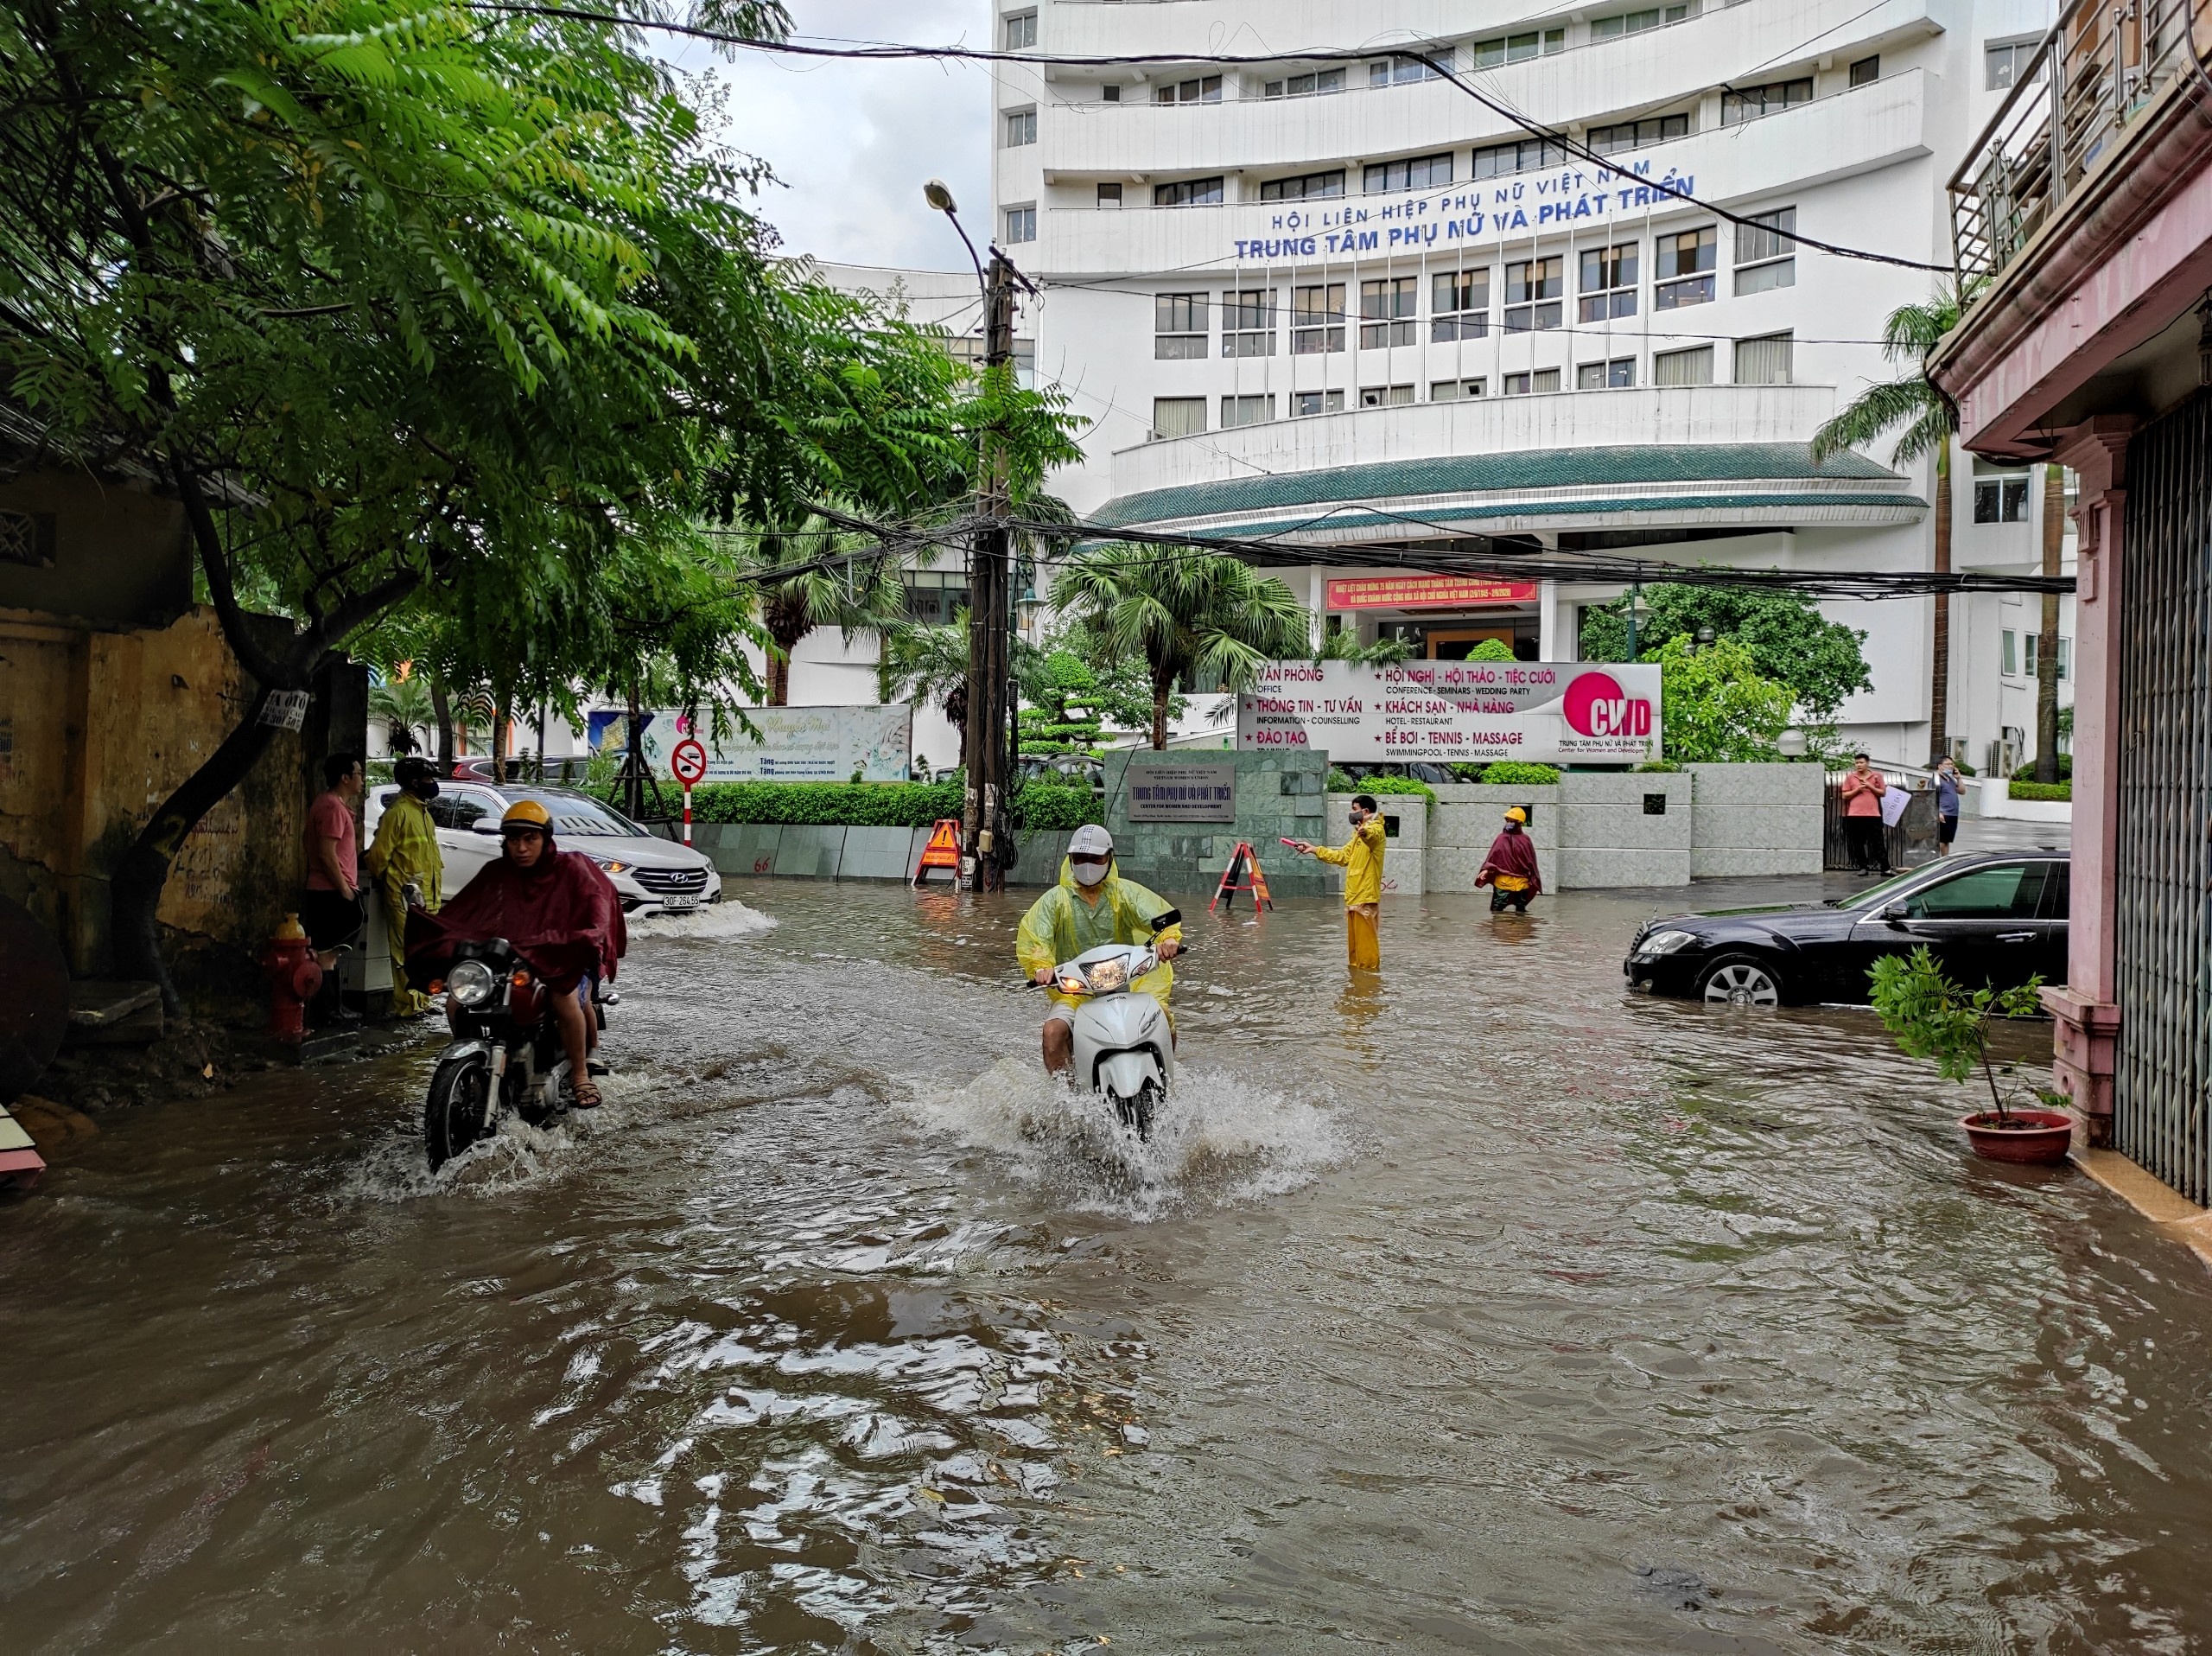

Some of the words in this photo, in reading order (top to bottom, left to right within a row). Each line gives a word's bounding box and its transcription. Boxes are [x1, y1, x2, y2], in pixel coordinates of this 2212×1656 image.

[1273, 211, 1309, 232] HỘI
[1324, 207, 1368, 226] LIÊN
[1382, 200, 1427, 220] HIỆP
[1442, 193, 1480, 212] PHỤ
[1496, 182, 1524, 203] NỮ
[1536, 173, 1583, 194] VIỆT
[1598, 160, 1650, 184] NAM
[1234, 237, 1315, 258] TRUNG
[1325, 229, 1378, 252] TÂM
[1389, 223, 1438, 247] PHỤ
[1448, 212, 1484, 239] NỮ
[1494, 205, 1529, 231] VÀ
[1539, 193, 1608, 224] PHÁT
[1618, 168, 1694, 209] TRIỂN
[1257, 666, 1281, 681] VĂN
[1284, 666, 1324, 681] PHÒNG
[1386, 667, 1404, 685] HỘI
[1408, 668, 1434, 685] NGHỊ
[1445, 667, 1464, 685] HỘI
[1466, 666, 1495, 683] THẢO
[1505, 668, 1526, 686] TIỆC
[1529, 668, 1555, 684] CƯỚI
[1386, 686, 1433, 695] CONFERENCE
[1257, 697, 1295, 713] THÔNG
[1298, 700, 1313, 712] TIN
[1325, 699, 1336, 712] TƯ
[1339, 695, 1362, 713] VẤN
[1386, 697, 1422, 713] KHÁCH
[1426, 701, 1446, 716] SẠN
[1457, 697, 1480, 713] NHÀ
[1484, 698, 1514, 713] HÀNG
[1591, 698, 1651, 736] CWD
[1257, 728, 1282, 743] ĐÀO
[1285, 731, 1306, 747] TẠO
[1386, 726, 1397, 744] BỂ
[1400, 731, 1418, 744] BƠI
[1428, 732, 1463, 744] TENNIS
[1473, 733, 1522, 744] MASSAGE
[1133, 787, 1151, 800] TRUNG
[1152, 784, 1166, 800] TÂM
[1166, 787, 1178, 801] PHỤ
[1179, 785, 1187, 800] NỮ
[1187, 784, 1196, 800] VÀ
[1197, 784, 1212, 800] PHÁT
[1213, 782, 1231, 800] TRIỂN
[754, 857, 770, 872] 66
